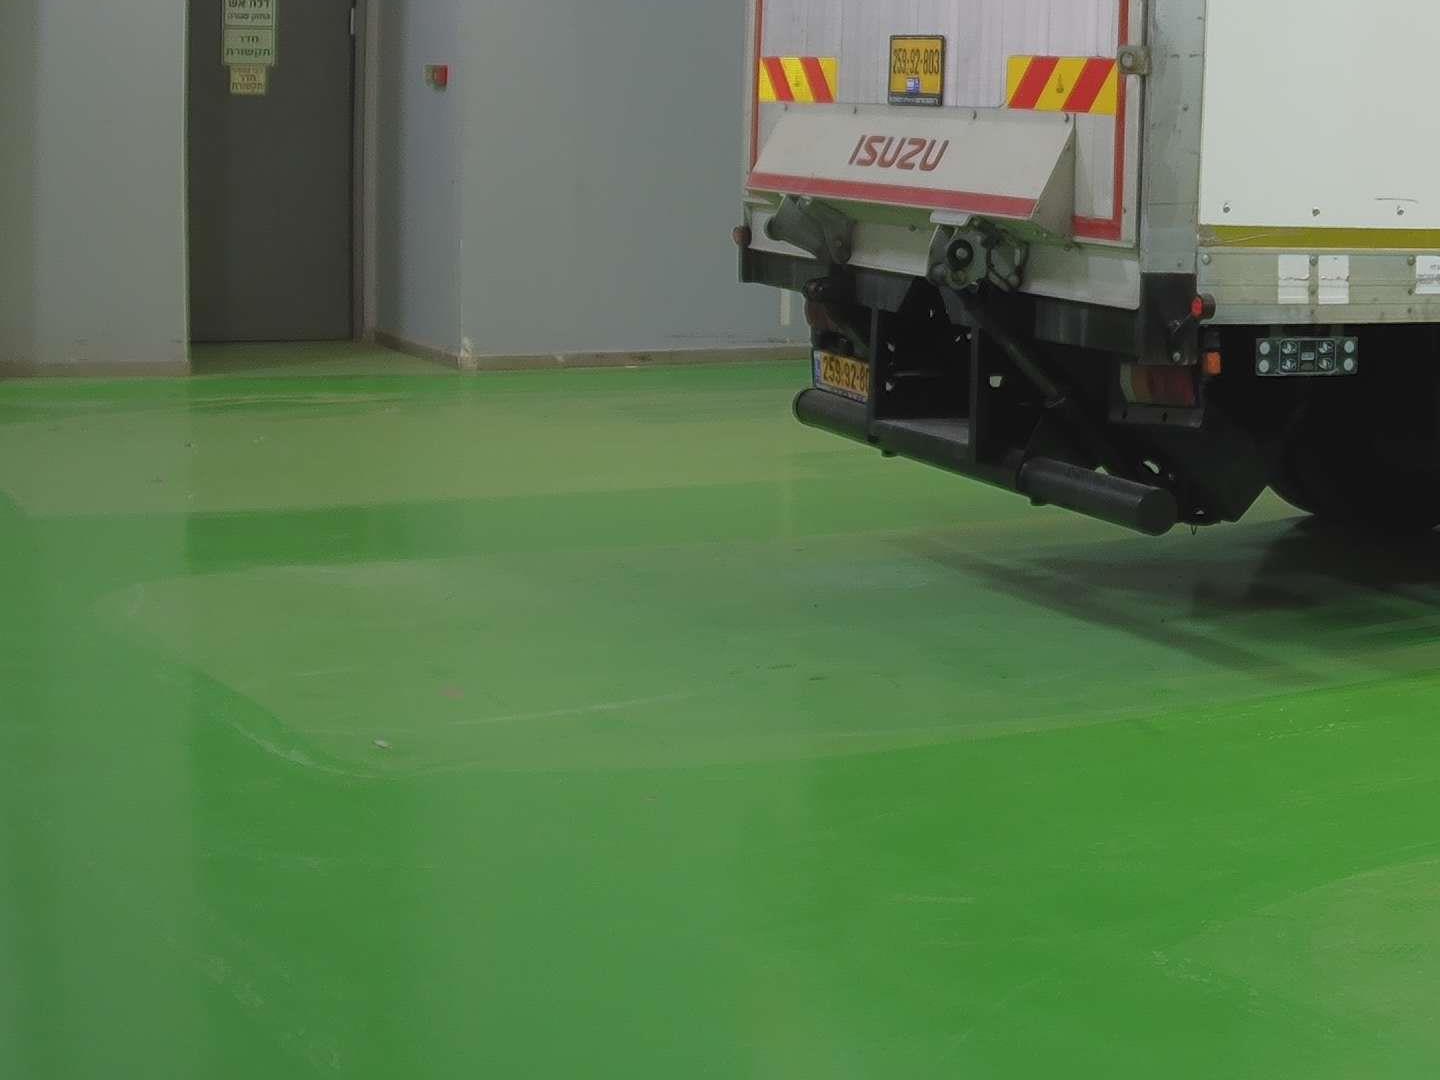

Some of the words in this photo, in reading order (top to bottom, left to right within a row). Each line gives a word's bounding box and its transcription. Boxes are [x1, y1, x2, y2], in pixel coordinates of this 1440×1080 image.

[228, 0, 246, 8] אש
[240, 35, 259, 43] חדר
[226, 48, 270, 58] תקשורת
[848, 134, 949, 171] ISUZU
[823, 355, 869, 392] 259-92-80
